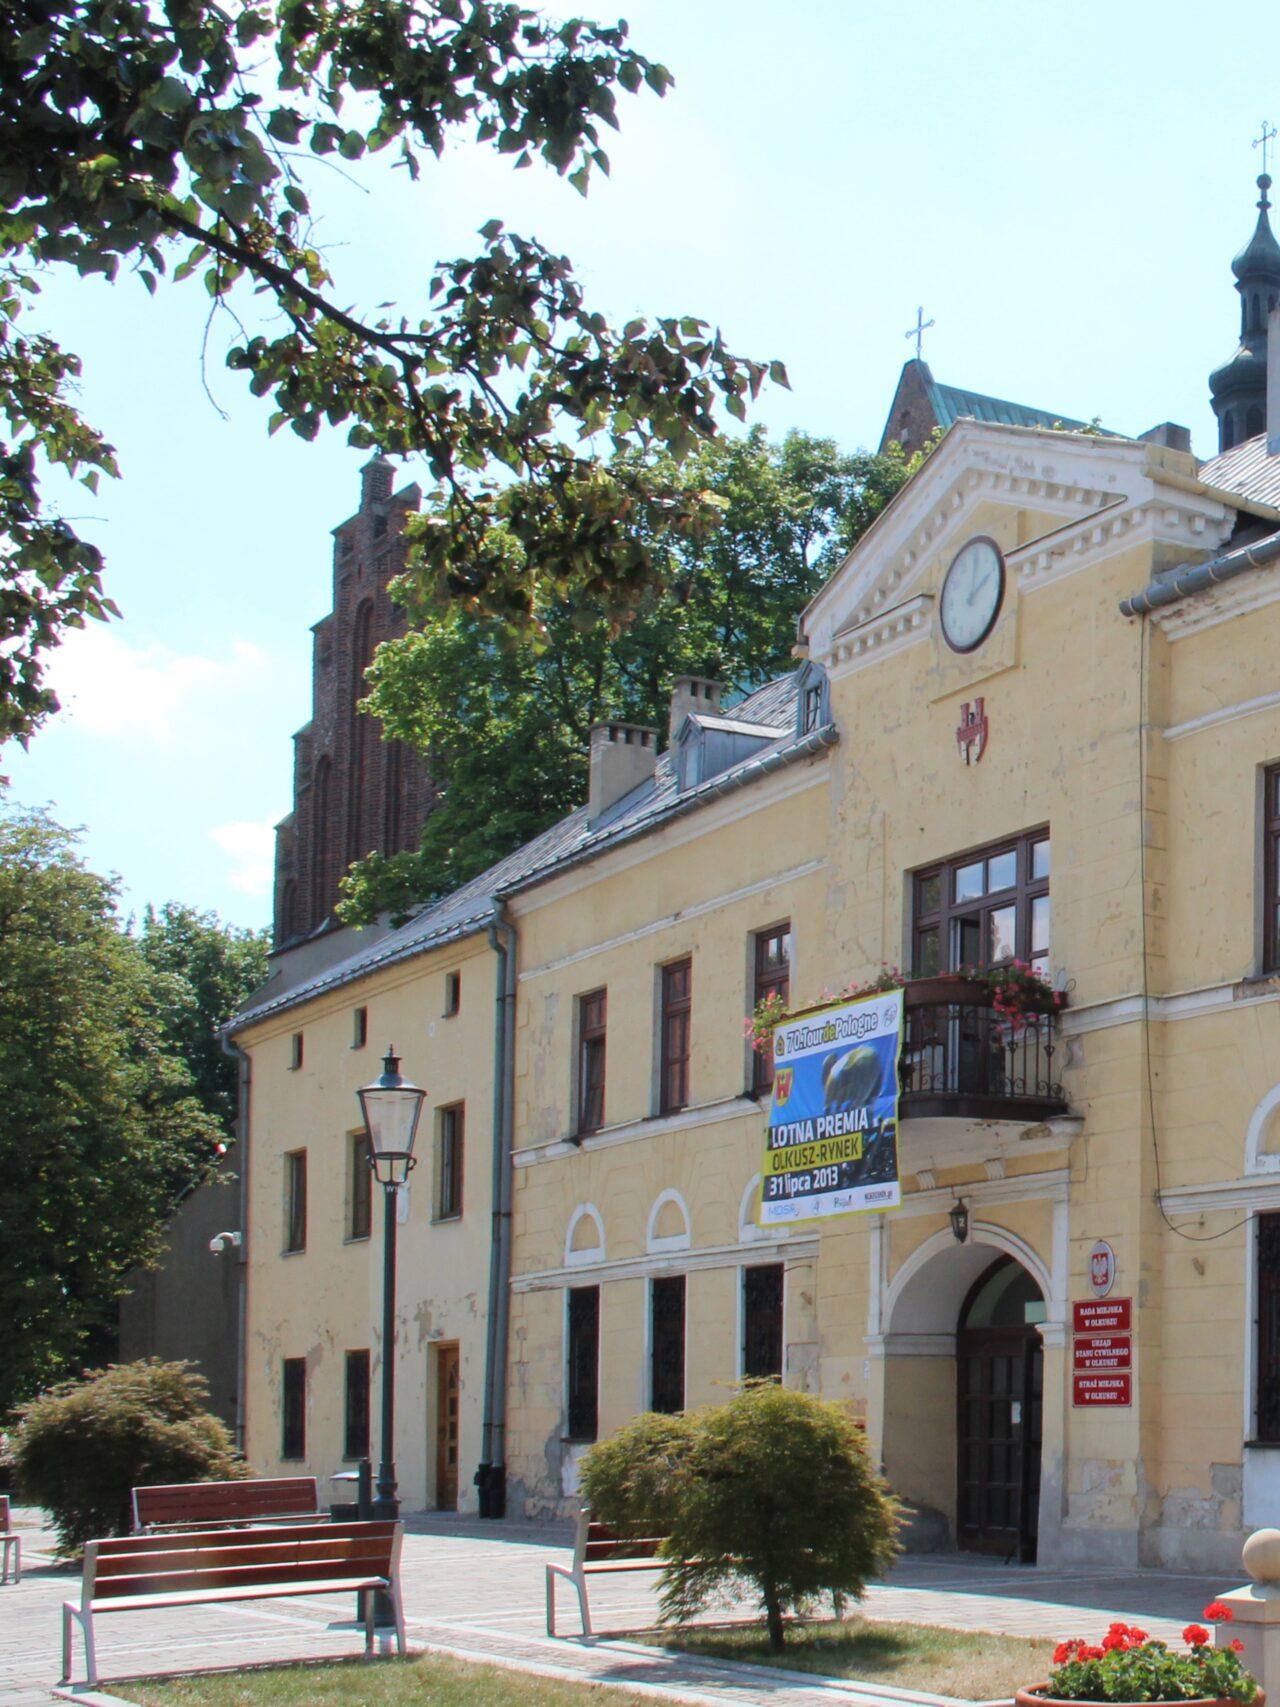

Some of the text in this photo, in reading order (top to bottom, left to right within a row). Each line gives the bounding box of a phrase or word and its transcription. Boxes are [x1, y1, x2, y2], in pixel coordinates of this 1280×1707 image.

[772, 1107, 868, 1148] LOTNA PREMIA
[772, 1136, 859, 1171] OLKUSZ-RYNEK
[769, 1166, 839, 1197] 31 lipca 2013
